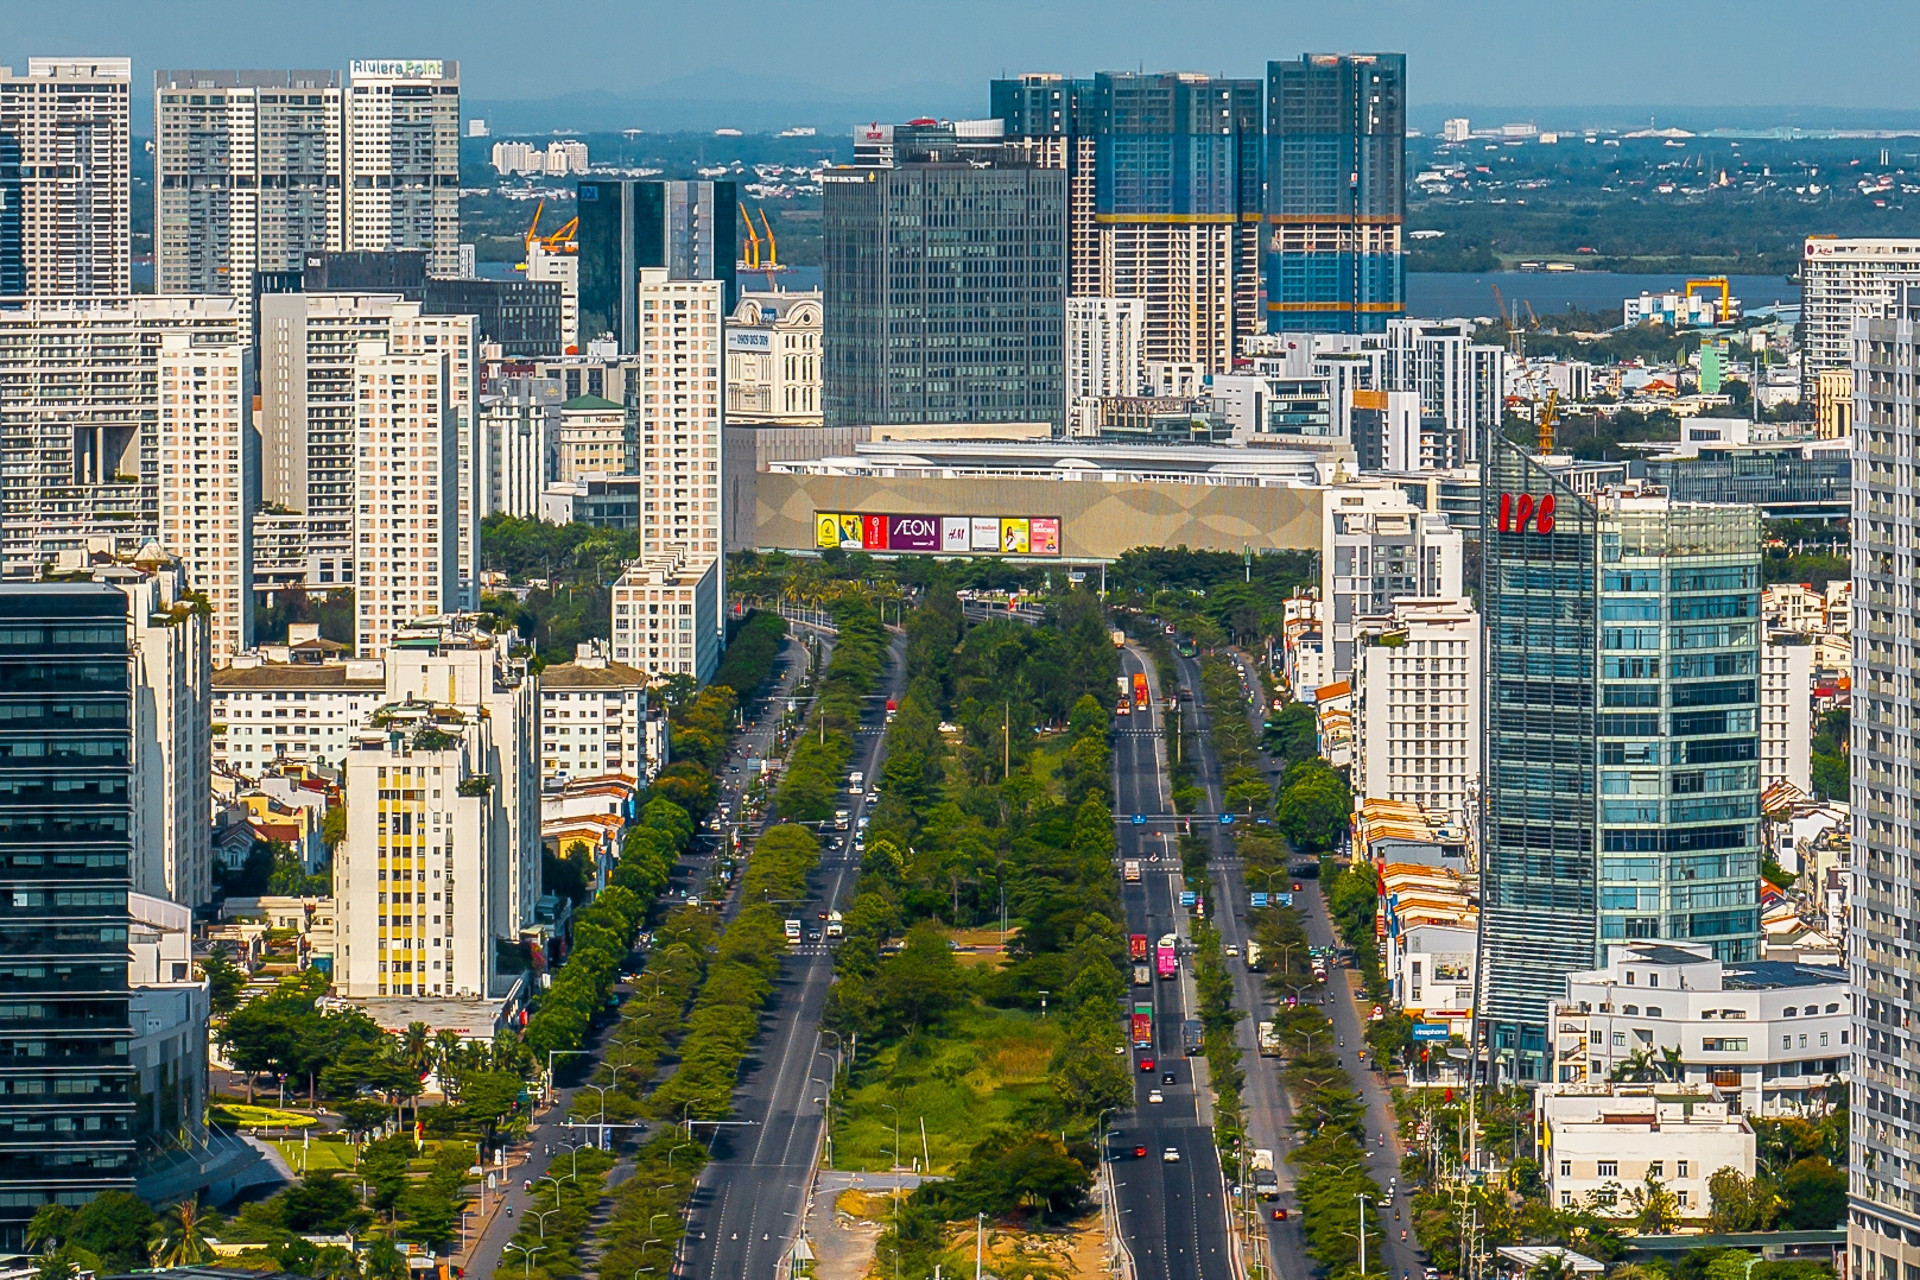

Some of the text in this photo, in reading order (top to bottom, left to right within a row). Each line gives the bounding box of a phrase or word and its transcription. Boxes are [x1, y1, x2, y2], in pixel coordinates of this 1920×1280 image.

[405, 60, 442, 75] Point
[1498, 493, 1555, 534] IPC
[1415, 1026, 1447, 1037] vinaphone
